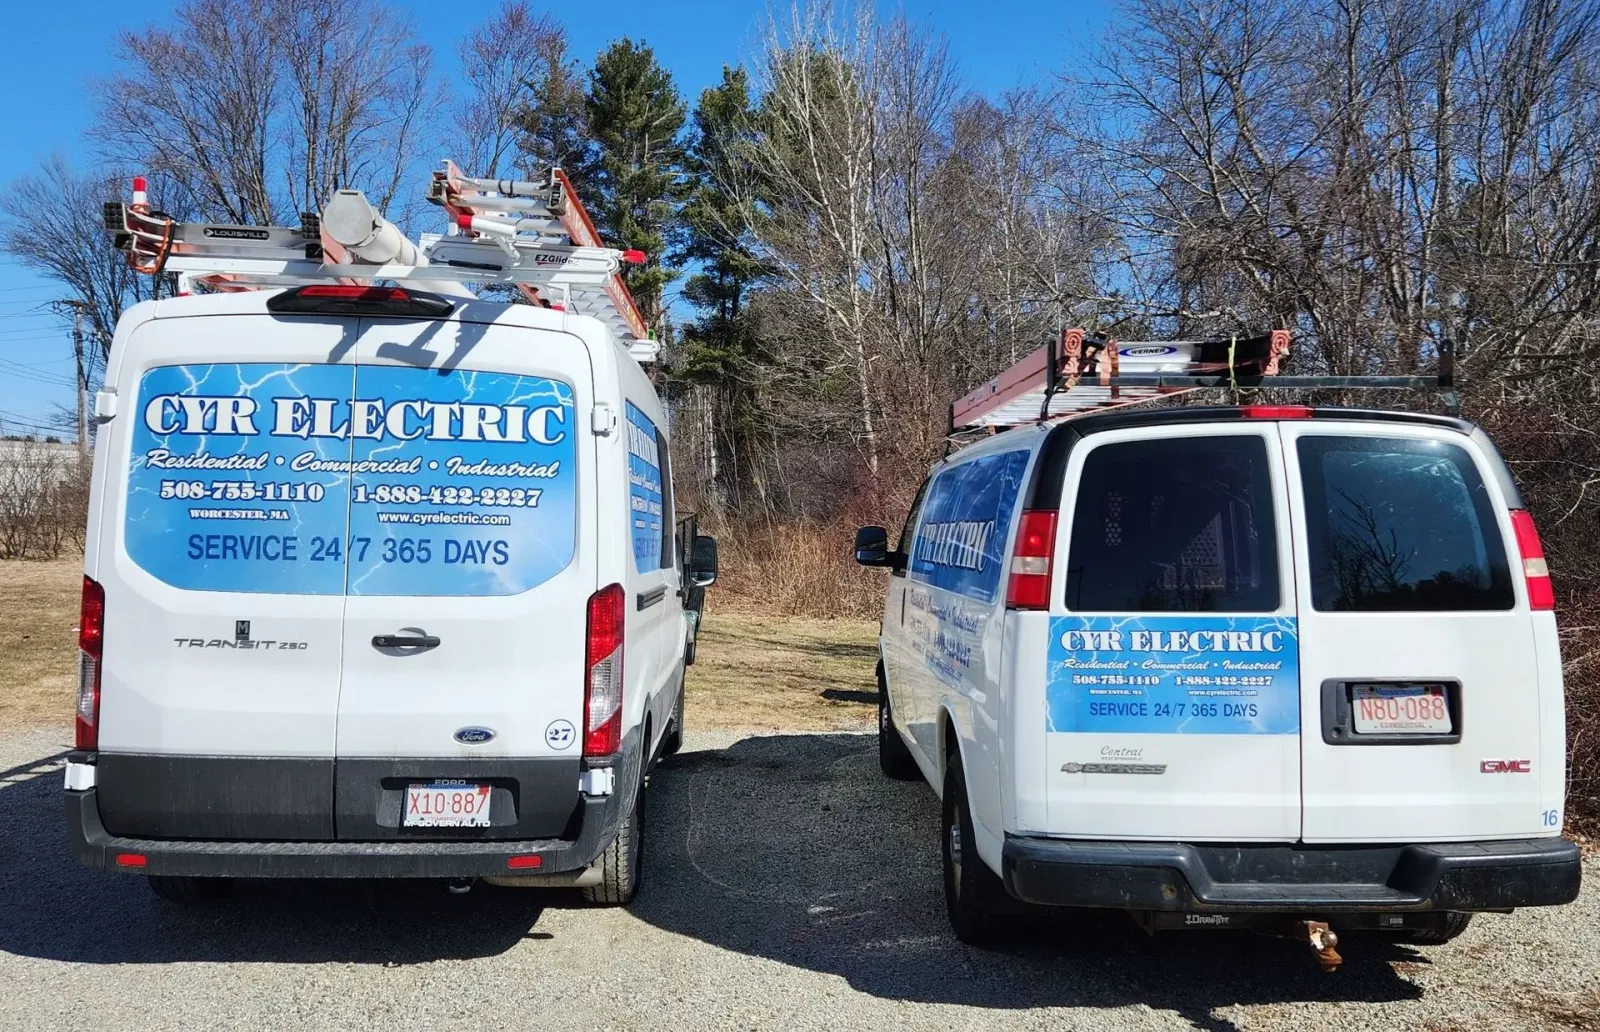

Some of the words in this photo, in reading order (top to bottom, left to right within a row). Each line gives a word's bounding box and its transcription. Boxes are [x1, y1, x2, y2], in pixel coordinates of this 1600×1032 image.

[214, 229, 268, 238] LOUISVILLE
[144, 393, 260, 436] CYR
[270, 395, 566, 445] ELECTRIC
[146, 447, 270, 471] Residential
[290, 450, 423, 474] Commercial
[446, 455, 560, 478] Industrial
[159, 479, 325, 503] 508-755-1110
[353, 484, 543, 508] 1-888-422-2227
[189, 508, 268, 520] WORCESTER,
[269, 510, 290, 520] MA
[377, 511, 511, 526] www.cyrelectric.com
[187, 534, 298, 561] SERVICE
[311, 535, 372, 564] 24/7
[381, 537, 432, 564] 365
[444, 539, 510, 565] DAYS
[932, 518, 996, 573] ELECTRIC
[237, 621, 249, 634] M
[174, 638, 277, 650] TRANSIT
[278, 642, 308, 650] 250
[1060, 629, 1123, 653] CYR
[1129, 629, 1284, 654] ELECTRIC
[1062, 658, 1130, 670] Residential
[1141, 659, 1210, 670] Commercial
[1221, 659, 1282, 671] Industrial
[1072, 675, 1160, 686] 508-755-1110
[1174, 675, 1273, 687] 1-888-422-2227
[1188, 689, 1258, 697] www.cyrelectric.com
[1089, 702, 1148, 717] SERVICE
[1153, 702, 1186, 718] 24/7
[1191, 703, 1218, 717] 365
[1223, 703, 1258, 718] DAYS
[462, 730, 486, 741] Ford
[549, 728, 571, 741] 27
[1100, 745, 1143, 756] Central
[1083, 763, 1168, 775] EXPRESS
[1480, 760, 1531, 773] GMC
[1541, 810, 1558, 826] 16
